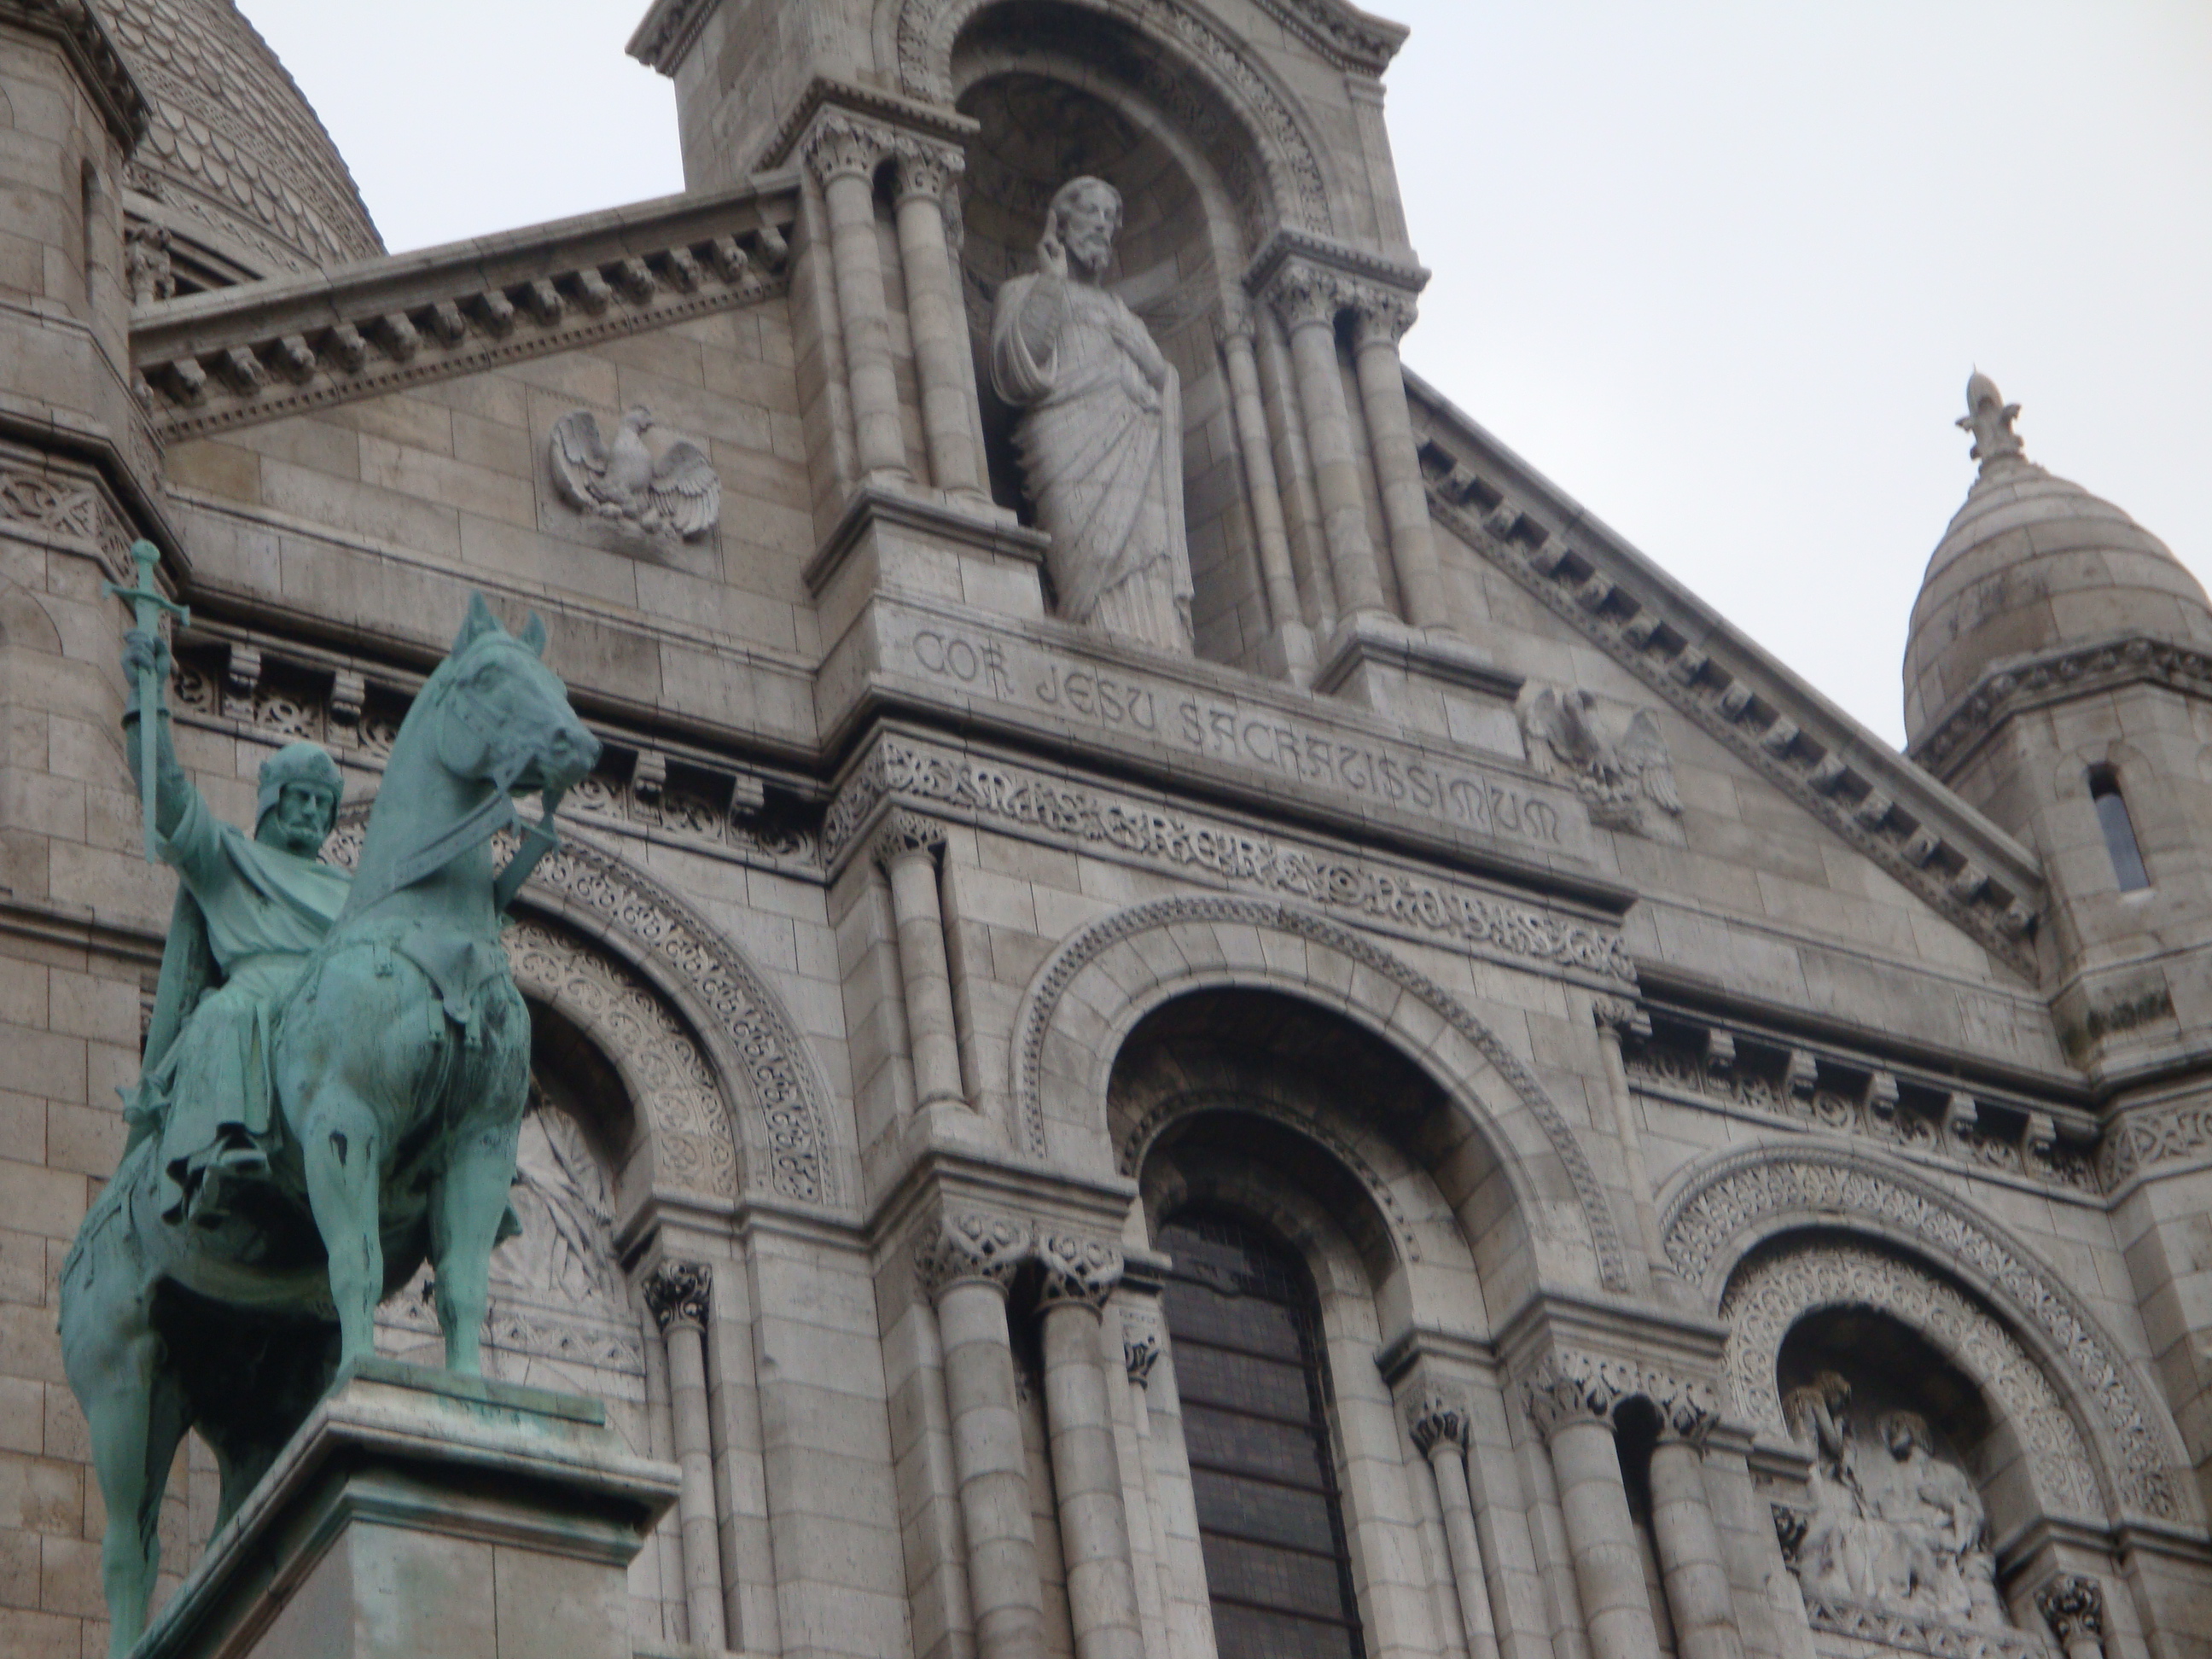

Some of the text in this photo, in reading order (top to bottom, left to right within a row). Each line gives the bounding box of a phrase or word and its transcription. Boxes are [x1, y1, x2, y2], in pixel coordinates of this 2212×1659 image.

[915, 632, 1561, 842] COR JESU SACRATISSIMUM
